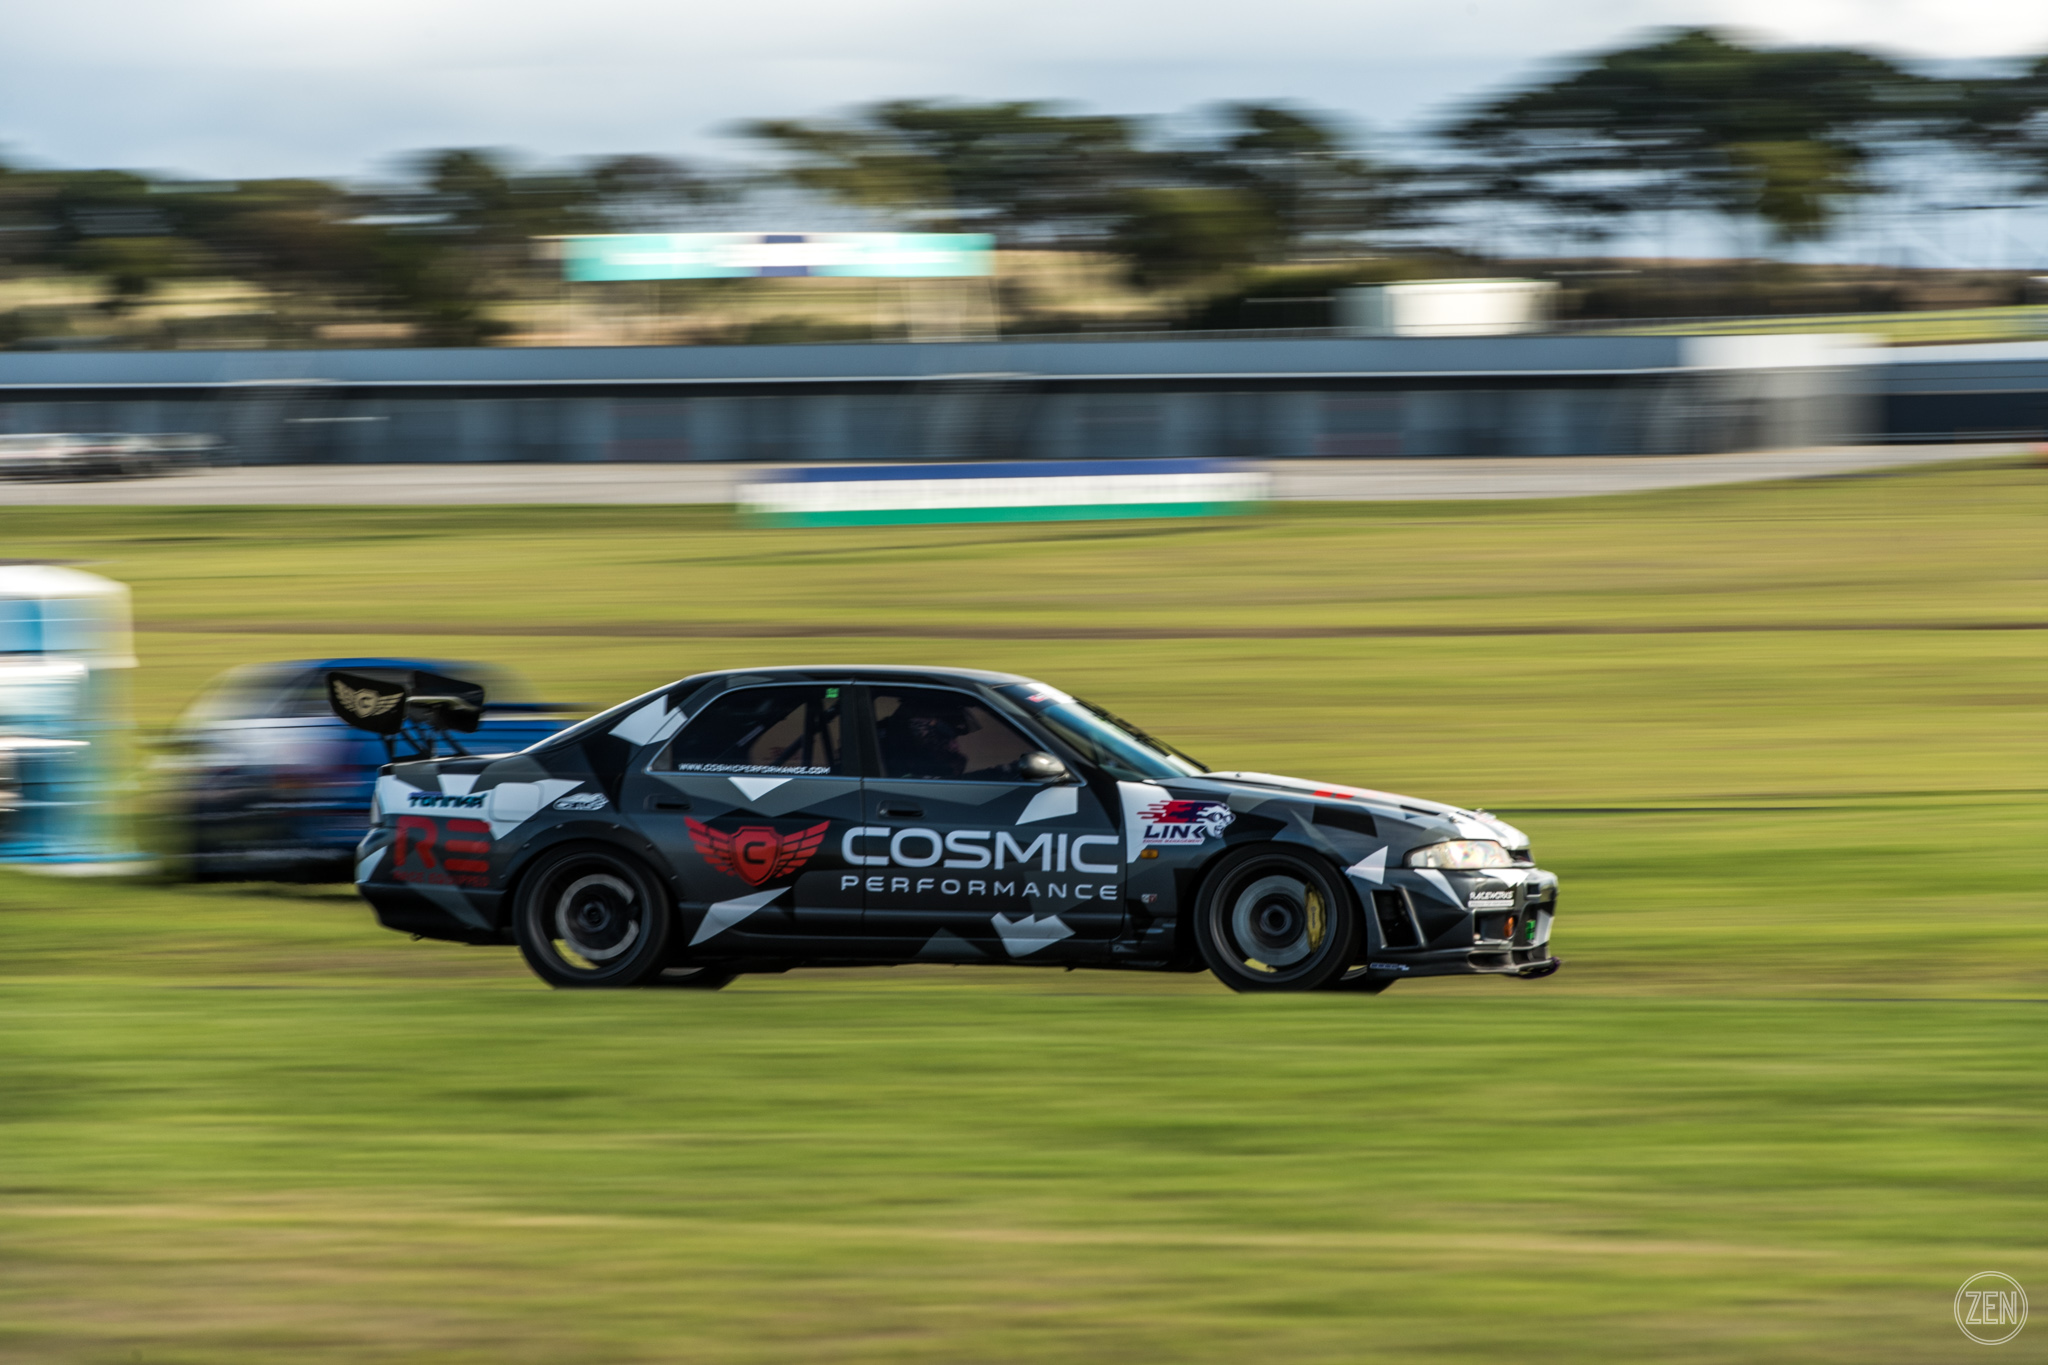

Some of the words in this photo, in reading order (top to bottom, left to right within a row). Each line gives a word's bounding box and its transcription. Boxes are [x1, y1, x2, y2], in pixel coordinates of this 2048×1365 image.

[678, 763, 831, 774] WWW.COSMICPERFORMANCE.COM
[1143, 825, 1207, 839] LINK
[743, 841, 766, 865] C
[841, 826, 1119, 874] COSMIC
[841, 875, 1118, 900] PERFORMANCE
[1469, 890, 1514, 900] RACEWORKS
